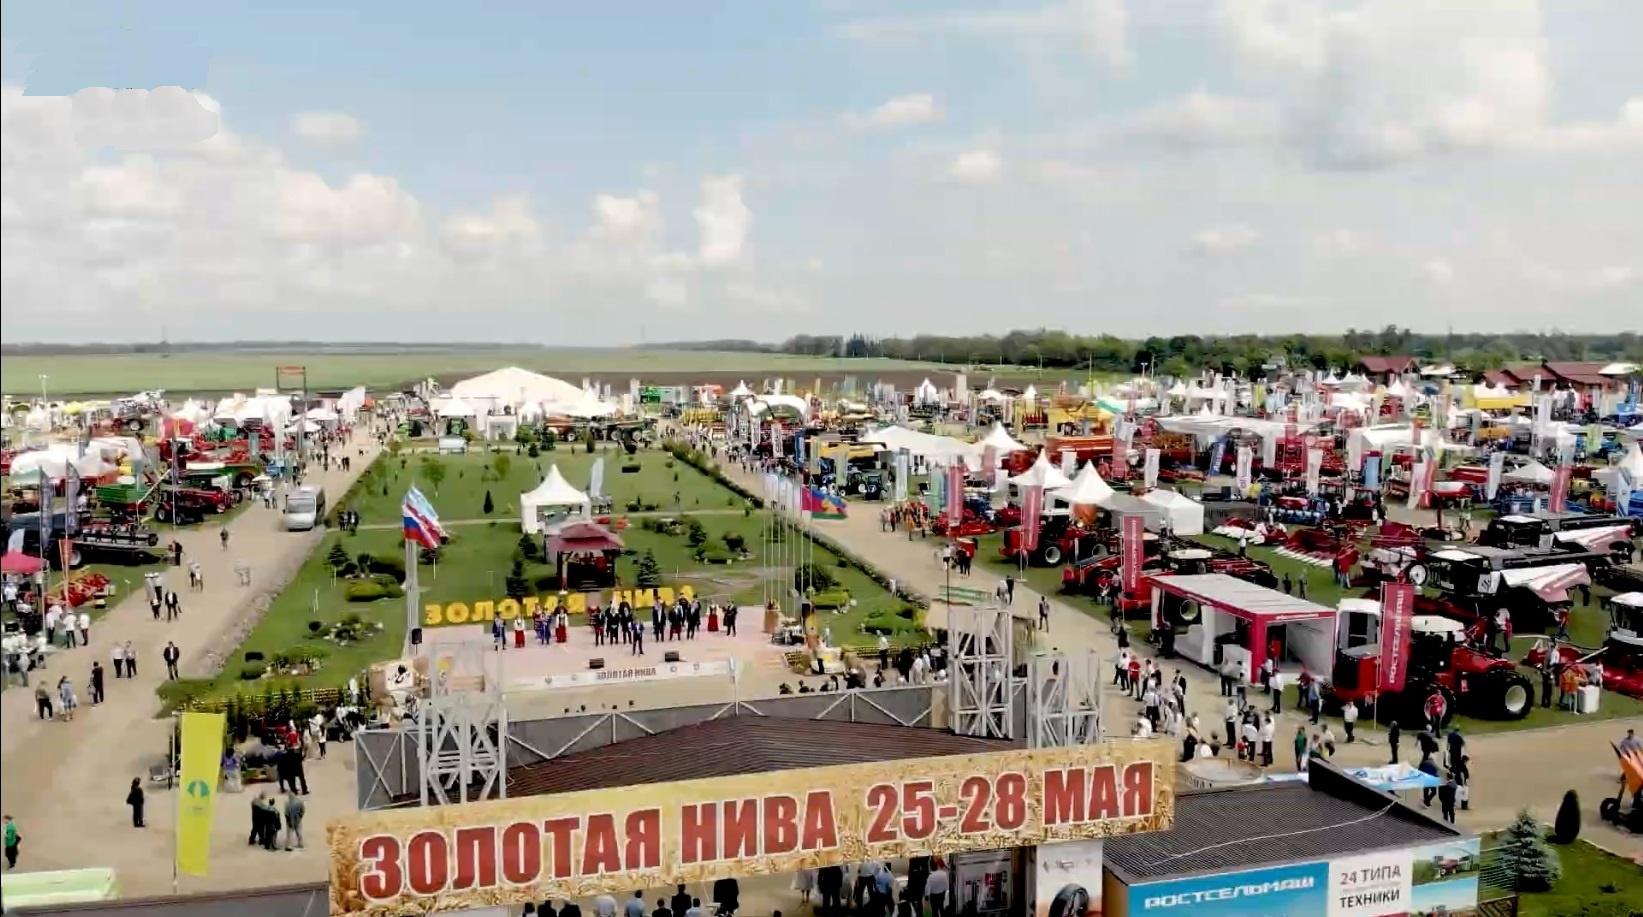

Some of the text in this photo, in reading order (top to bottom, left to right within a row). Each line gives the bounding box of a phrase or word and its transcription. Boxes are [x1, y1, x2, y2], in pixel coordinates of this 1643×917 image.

[360, 761, 1153, 900] ЗОЛОТАЯ НИВА 25-28 МАЯ
[1340, 865, 1402, 885] 24 ТИПА
[1144, 876, 1315, 910] РОСТСЕЛЬМАШ
[1340, 889, 1400, 908] ТЕХНИКИ
